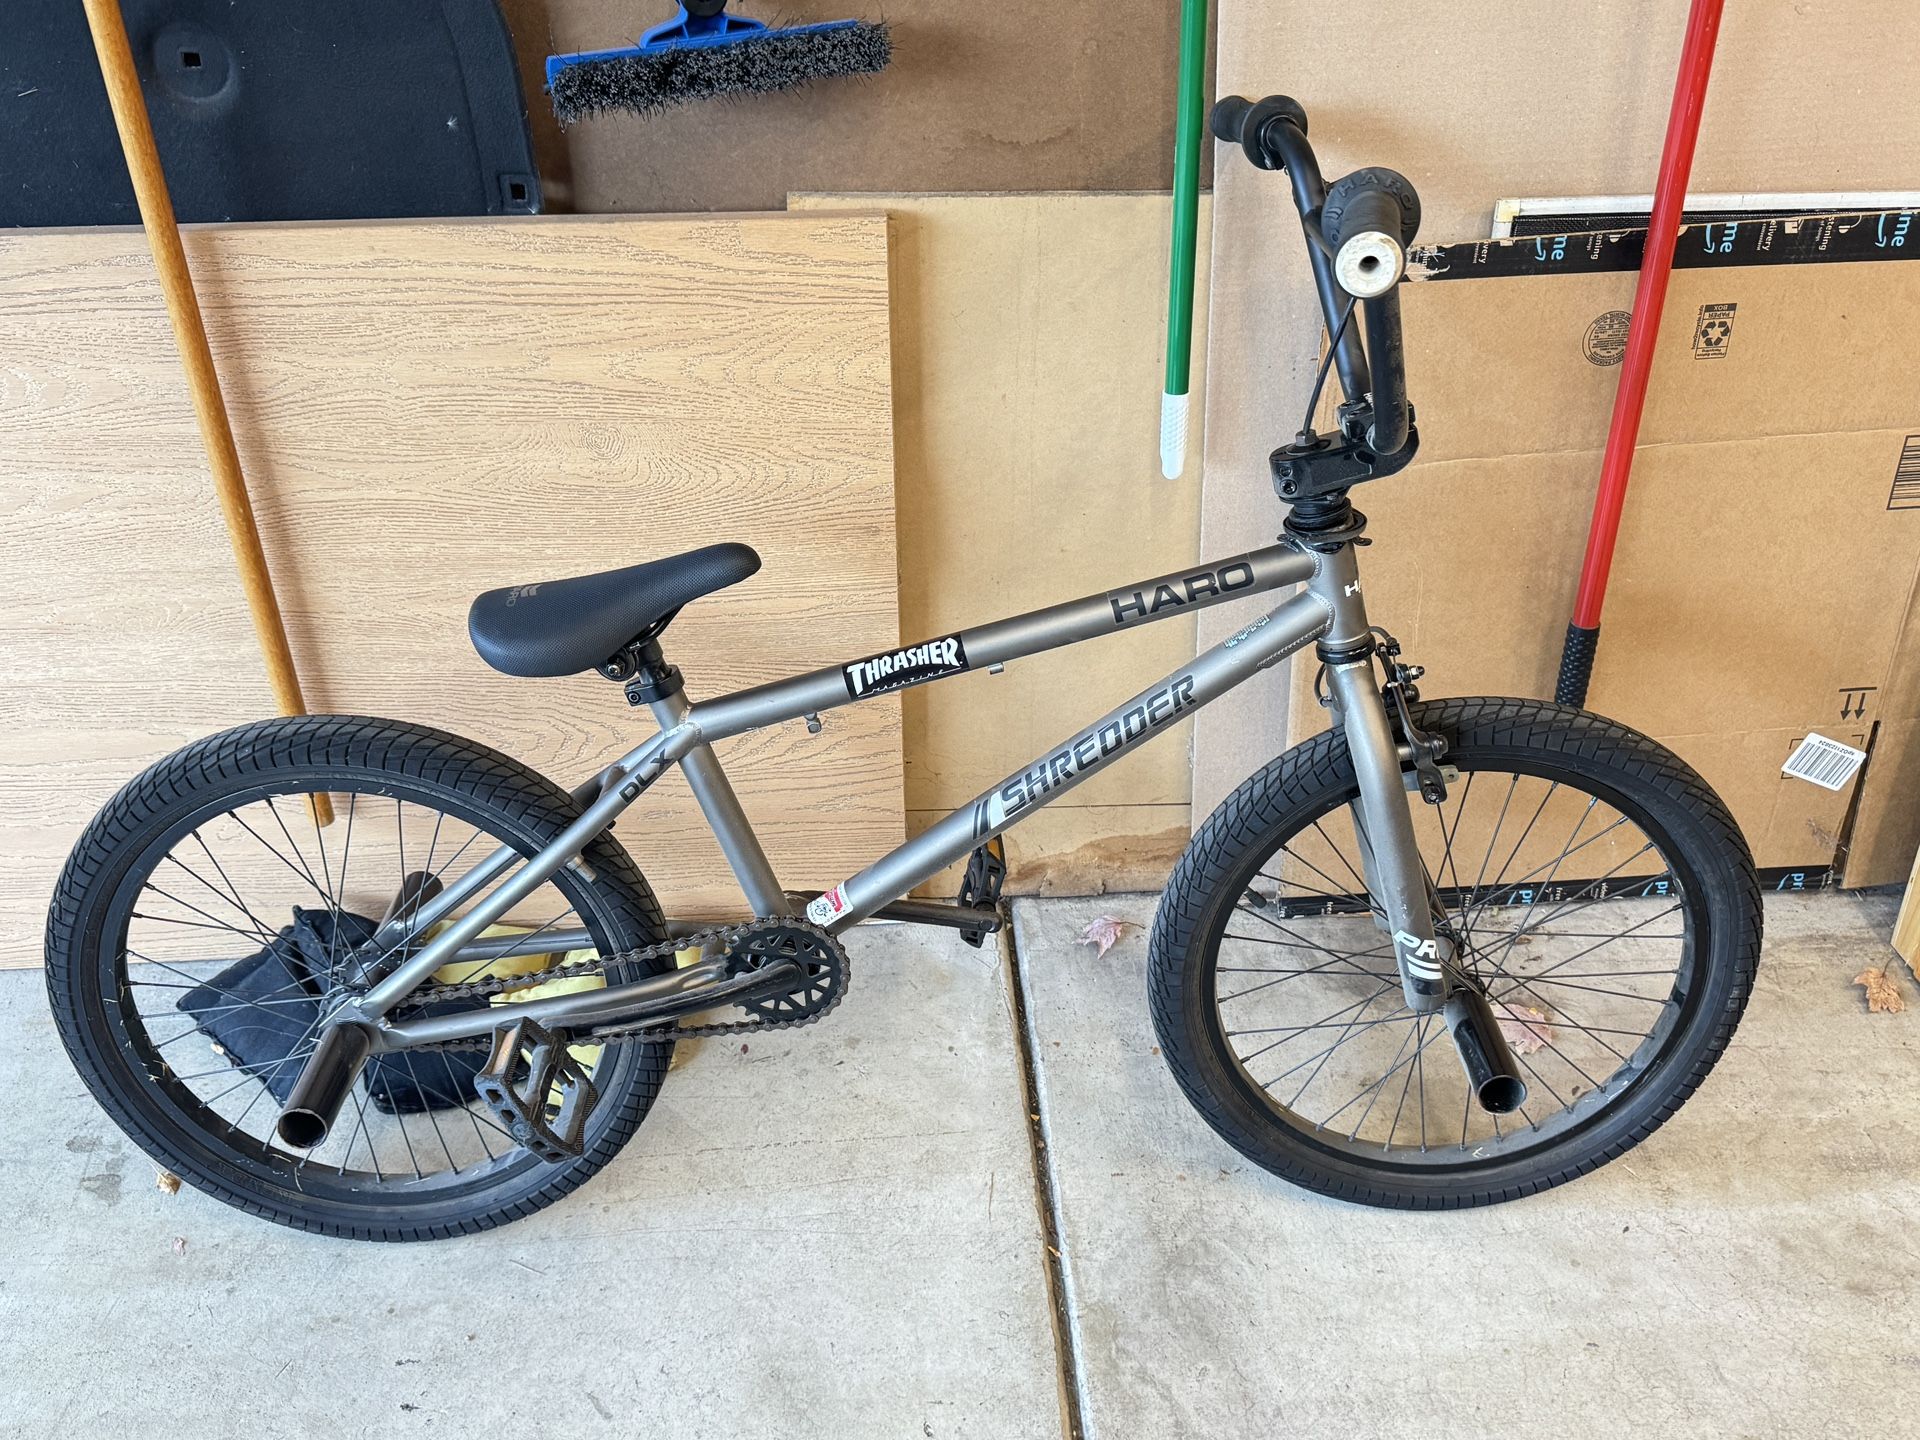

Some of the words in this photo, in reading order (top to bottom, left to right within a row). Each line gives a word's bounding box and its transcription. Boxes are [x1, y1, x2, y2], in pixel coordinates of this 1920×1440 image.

[1109, 562, 1255, 624] HARO
[846, 637, 962, 696] THRASHER
[866, 668, 950, 695] MAGAZINE
[1001, 674, 1197, 818] SHREDDER
[618, 747, 675, 803] DLX
[1393, 929, 1440, 960] PR
